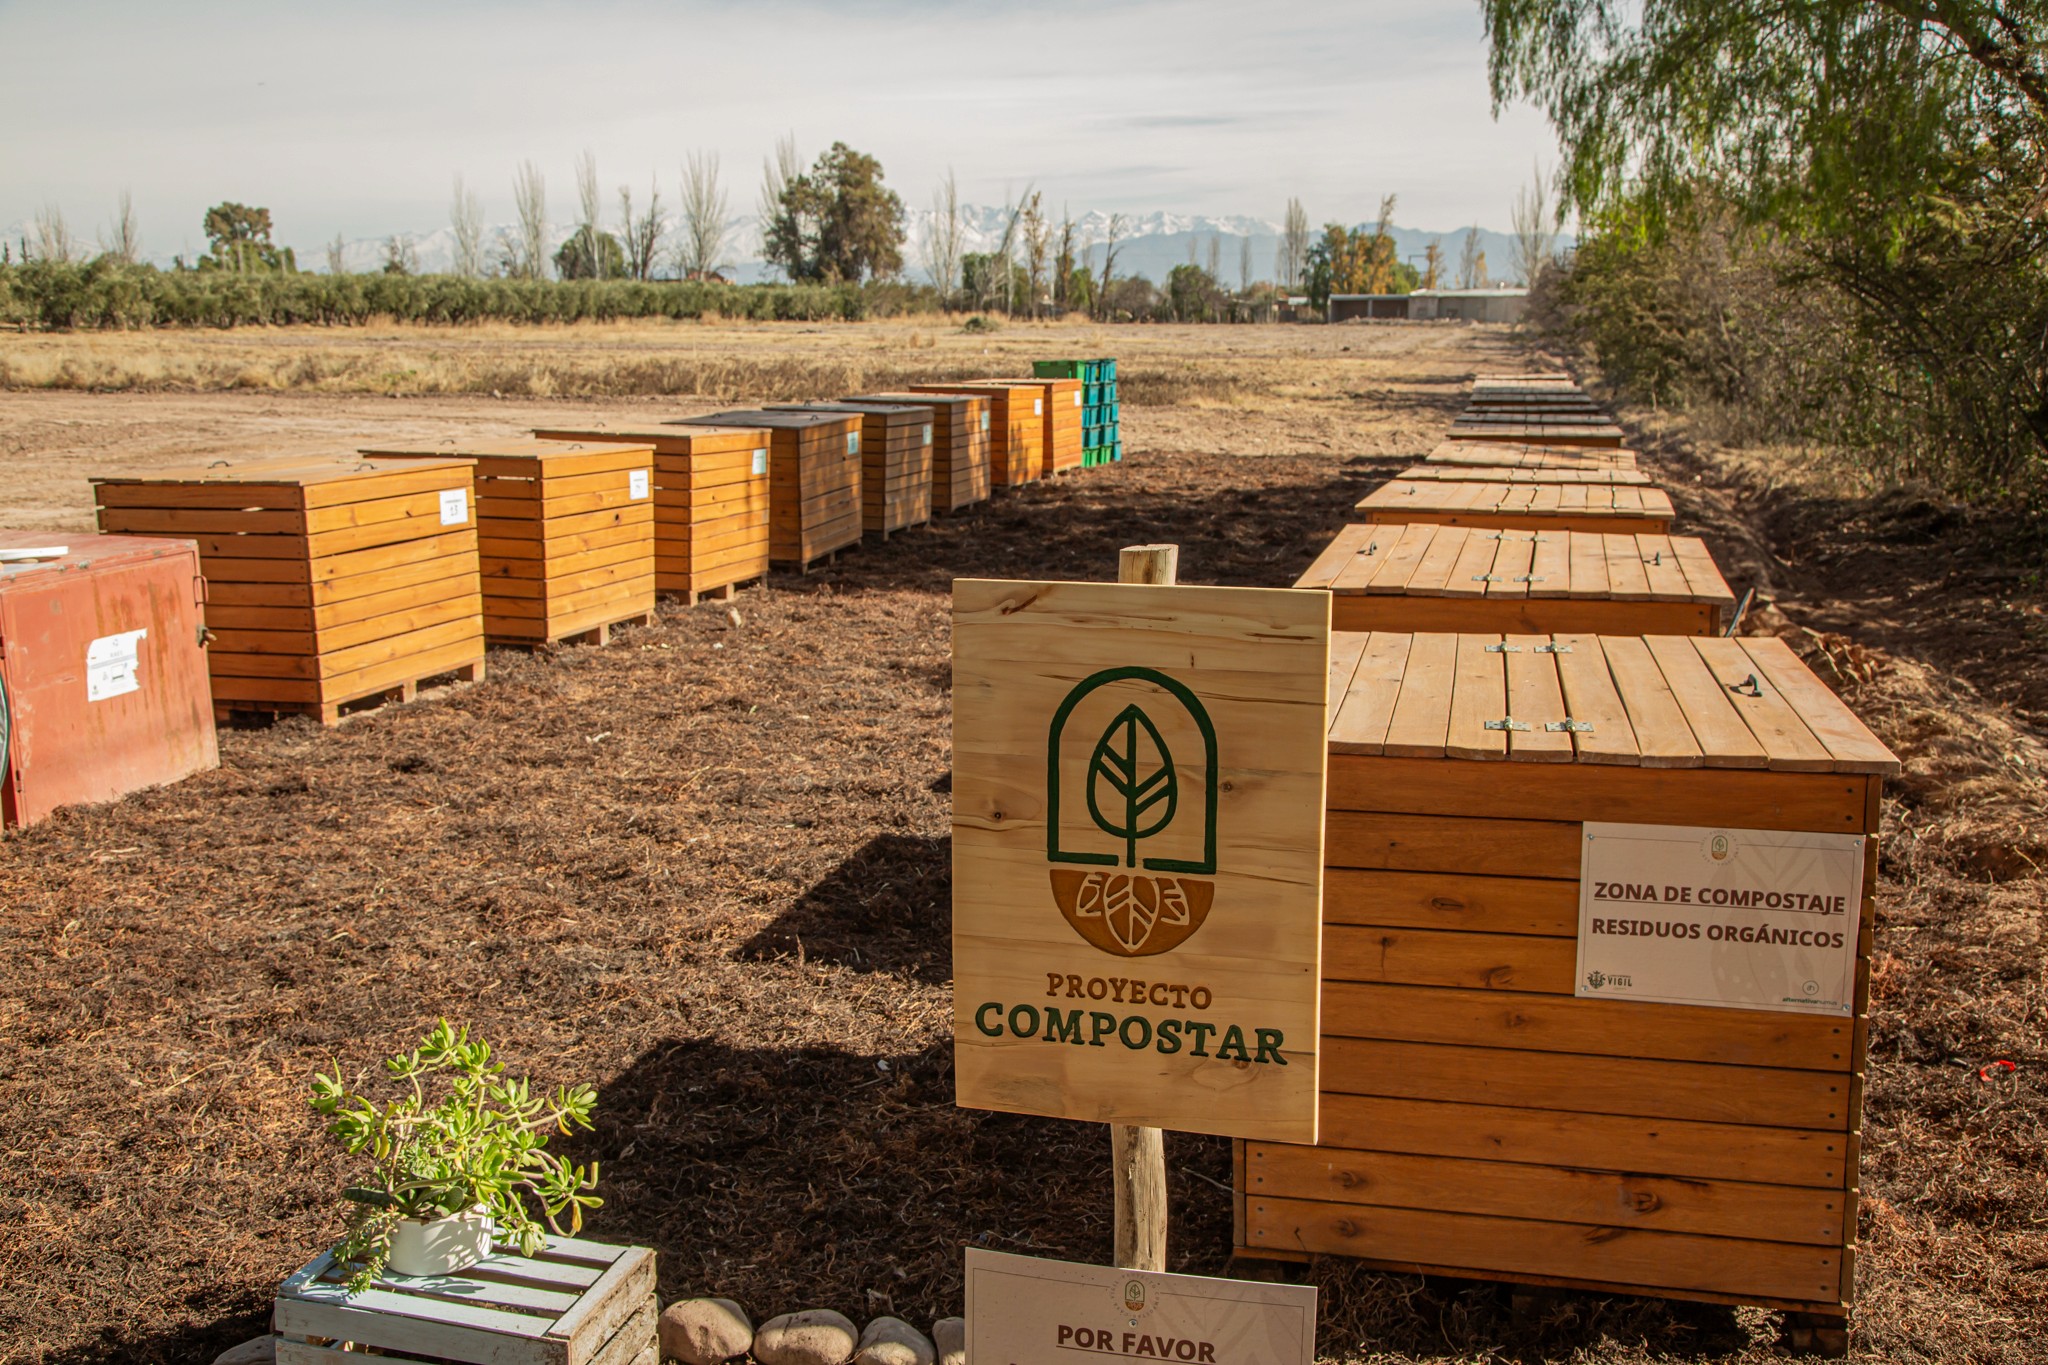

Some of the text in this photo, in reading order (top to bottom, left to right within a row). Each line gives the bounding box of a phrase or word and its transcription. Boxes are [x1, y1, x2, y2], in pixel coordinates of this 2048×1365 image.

[1594, 882, 1846, 915] ZONA DE COMPOSTAJE
[1592, 918, 1844, 949] RESIDUOS ORGÁNICOS
[1046, 972, 1213, 1010] PROYECTO
[1607, 977, 1633, 987] VIGIL
[975, 1002, 1288, 1066] COMPOSTAR
[1057, 1324, 1217, 1364] POR FAVOR
